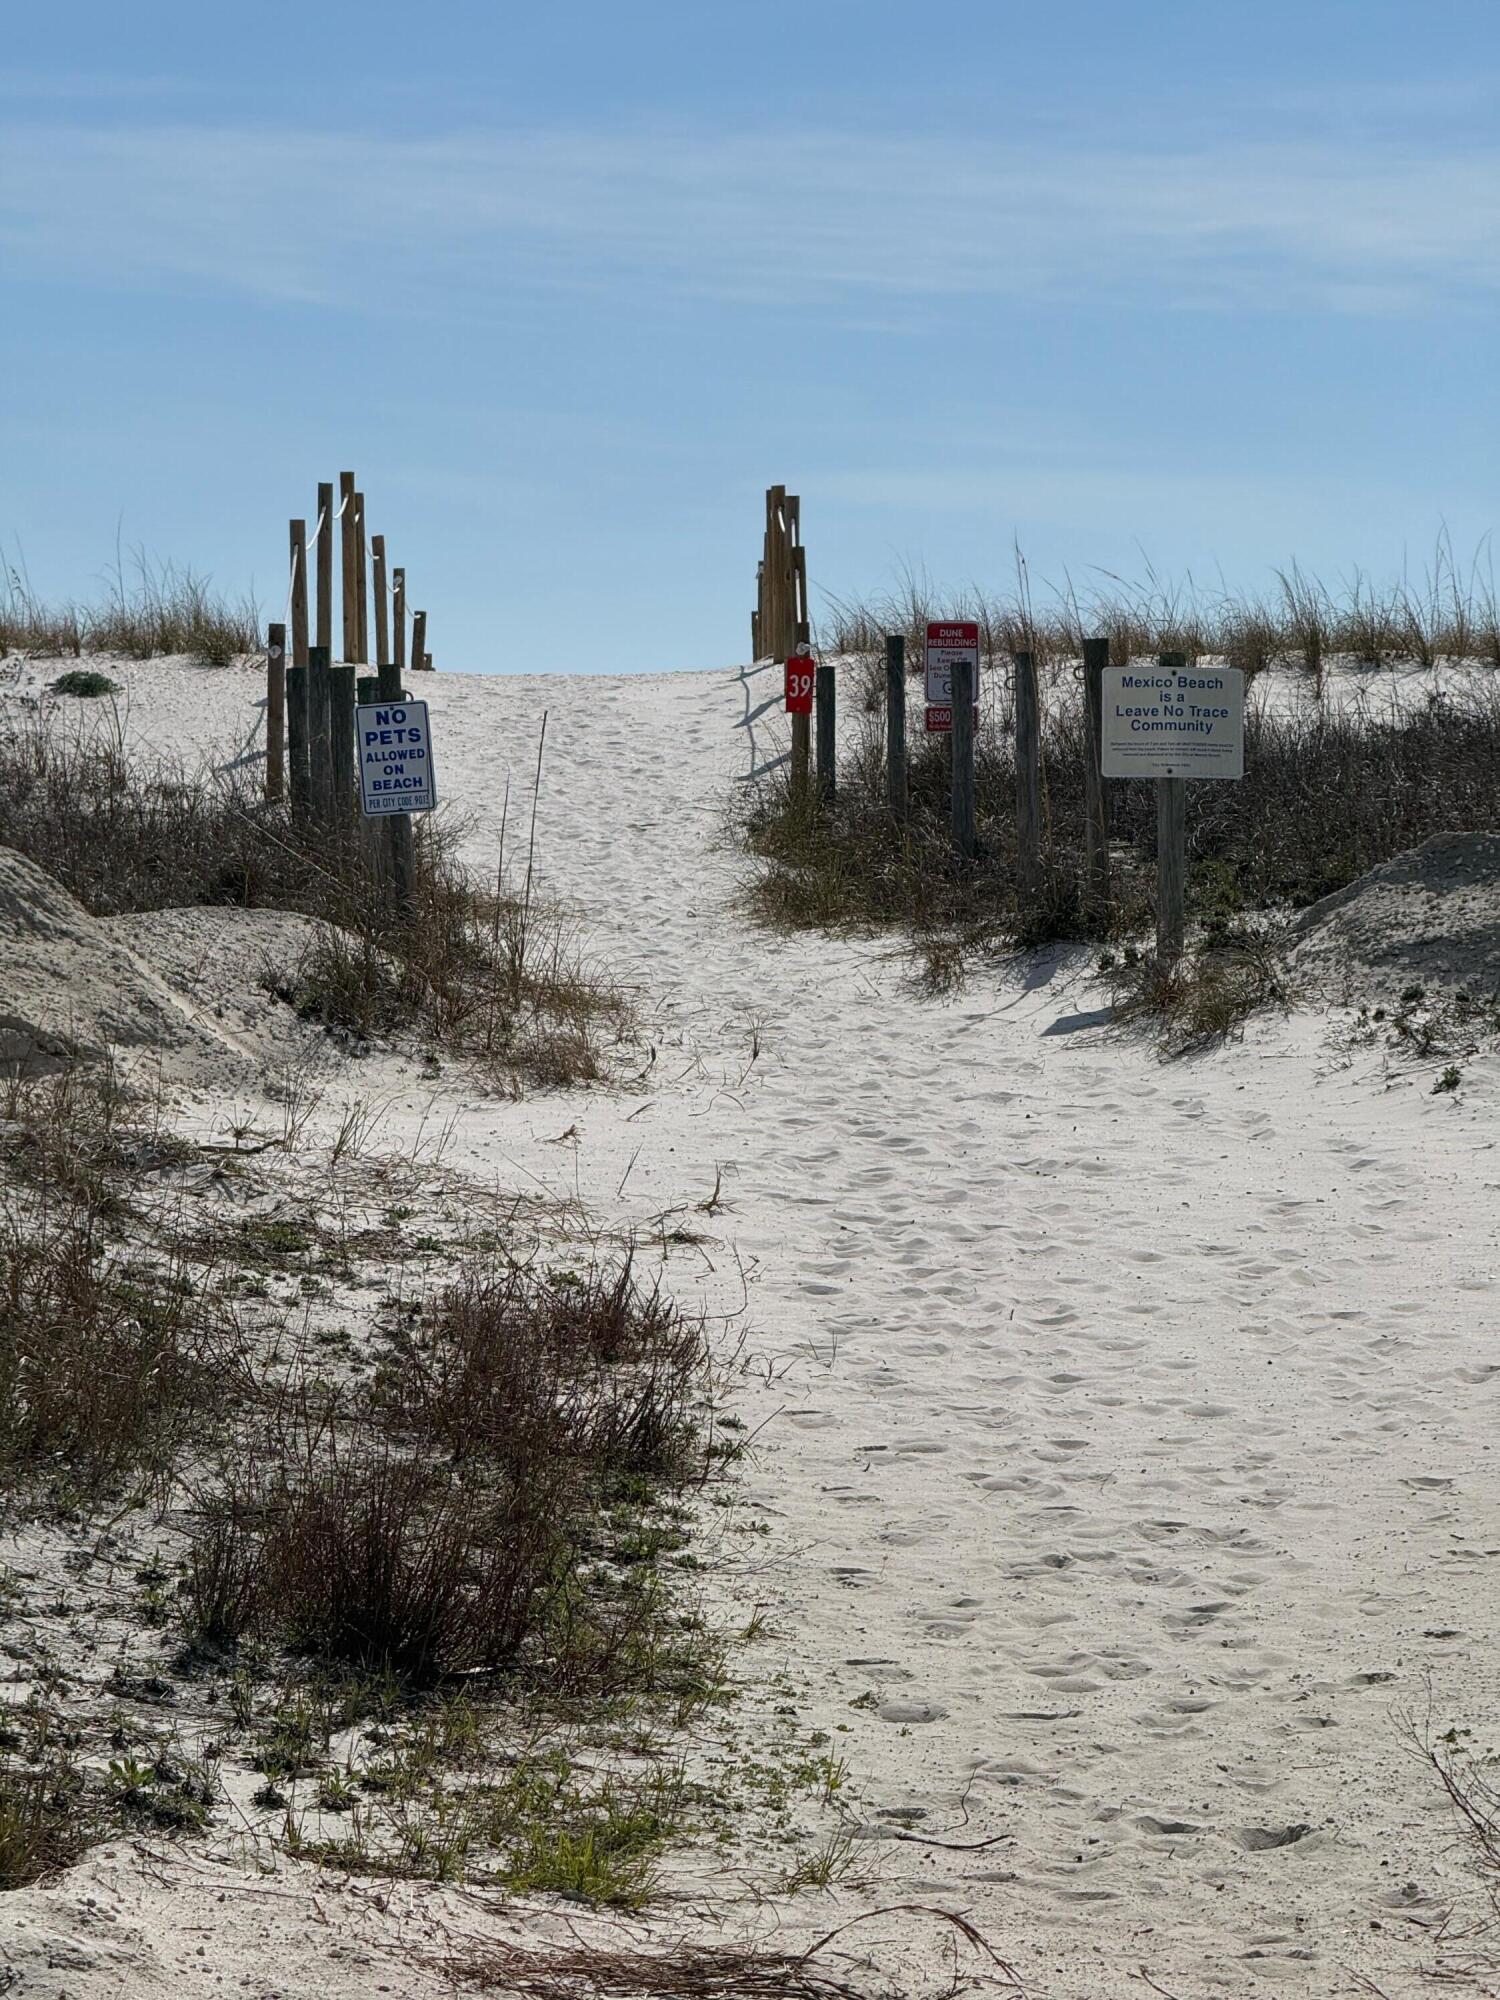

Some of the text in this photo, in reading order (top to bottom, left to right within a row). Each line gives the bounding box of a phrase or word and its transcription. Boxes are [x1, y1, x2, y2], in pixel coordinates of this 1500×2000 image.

[940, 629, 963, 637] DUNE
[928, 638, 977, 647] REBUILDING
[789, 674, 810, 697] 39
[1122, 676, 1223, 689] Mexico Beach
[1160, 691, 1185, 702] is a
[376, 709, 407, 725] NO
[929, 710, 951, 722] $500
[1116, 705, 1229, 718] Leave No Trace
[1131, 719, 1213, 735] Community
[365, 728, 421, 746] PETS
[366, 748, 425, 763] ALLOWED
[384, 764, 404, 776] ON
[373, 777, 423, 791] BEACH
[369, 799, 381, 809] PER
[383, 797, 395, 808] CITY
[398, 796, 412, 806] CODE
